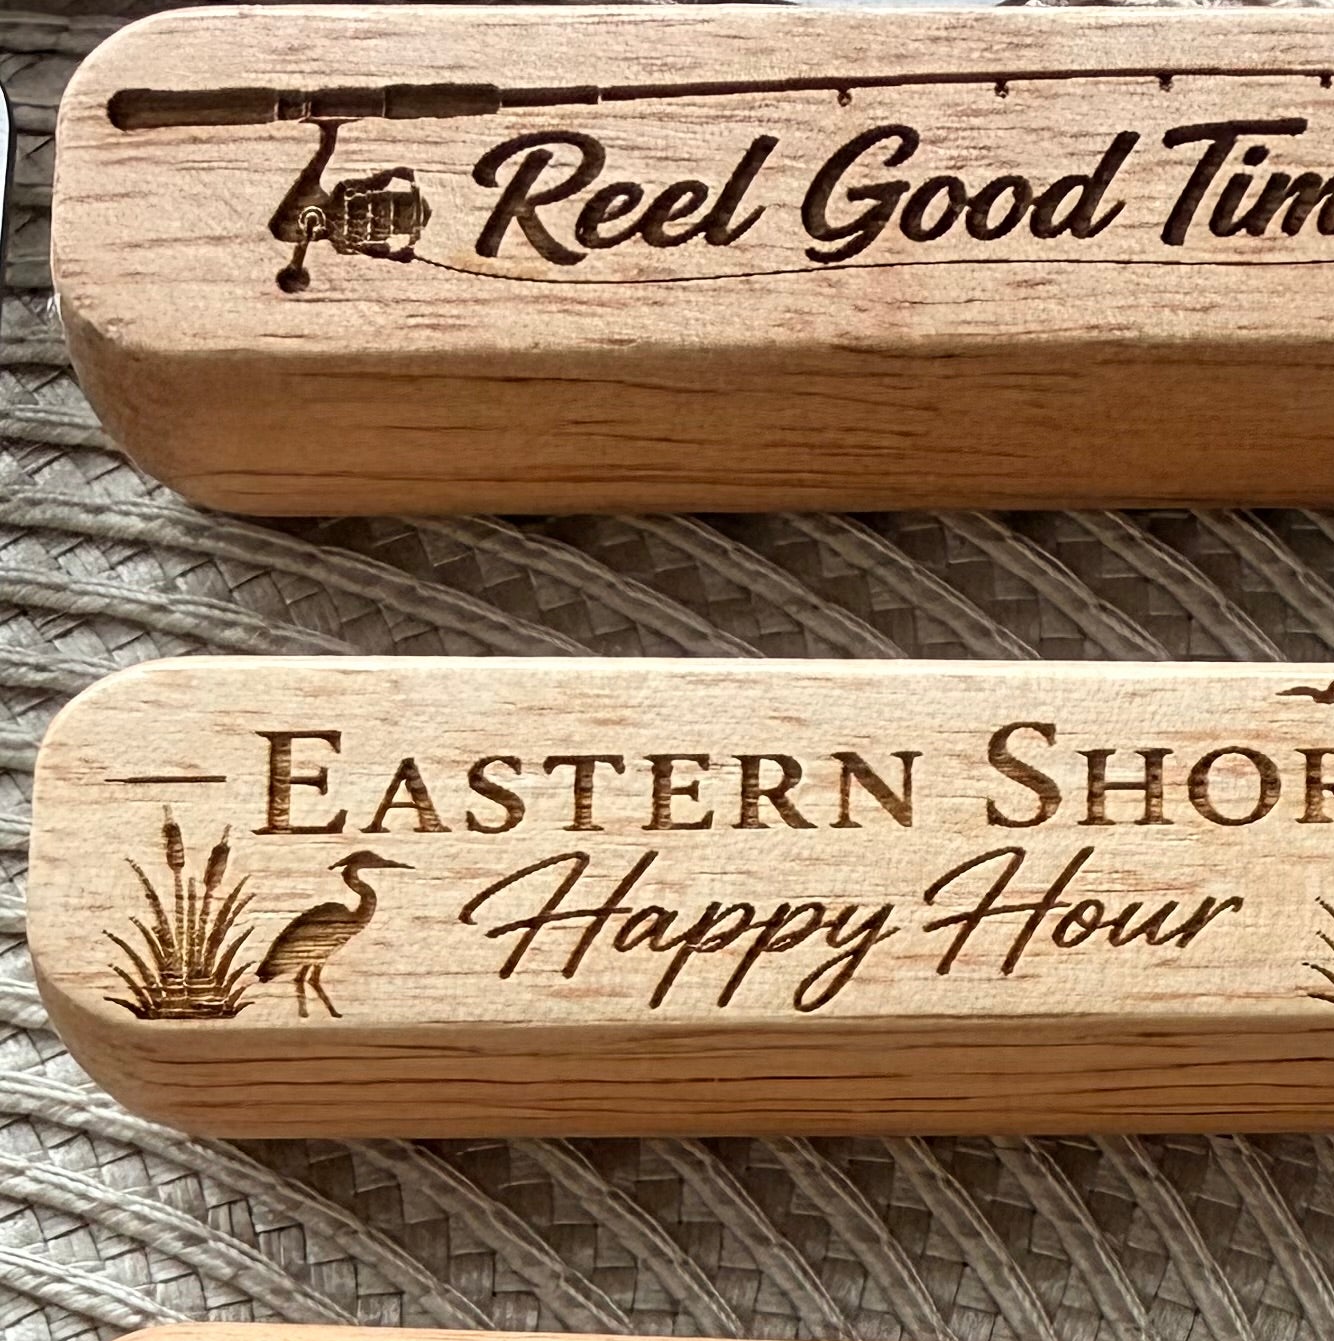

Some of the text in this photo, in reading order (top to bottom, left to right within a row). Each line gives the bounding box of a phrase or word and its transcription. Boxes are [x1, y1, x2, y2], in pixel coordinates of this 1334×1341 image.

[473, 130, 778, 265] Reel
[799, 124, 1139, 263] Good
[251, 729, 922, 835] EASTERN
[458, 845, 1243, 1013] Happy Hour
